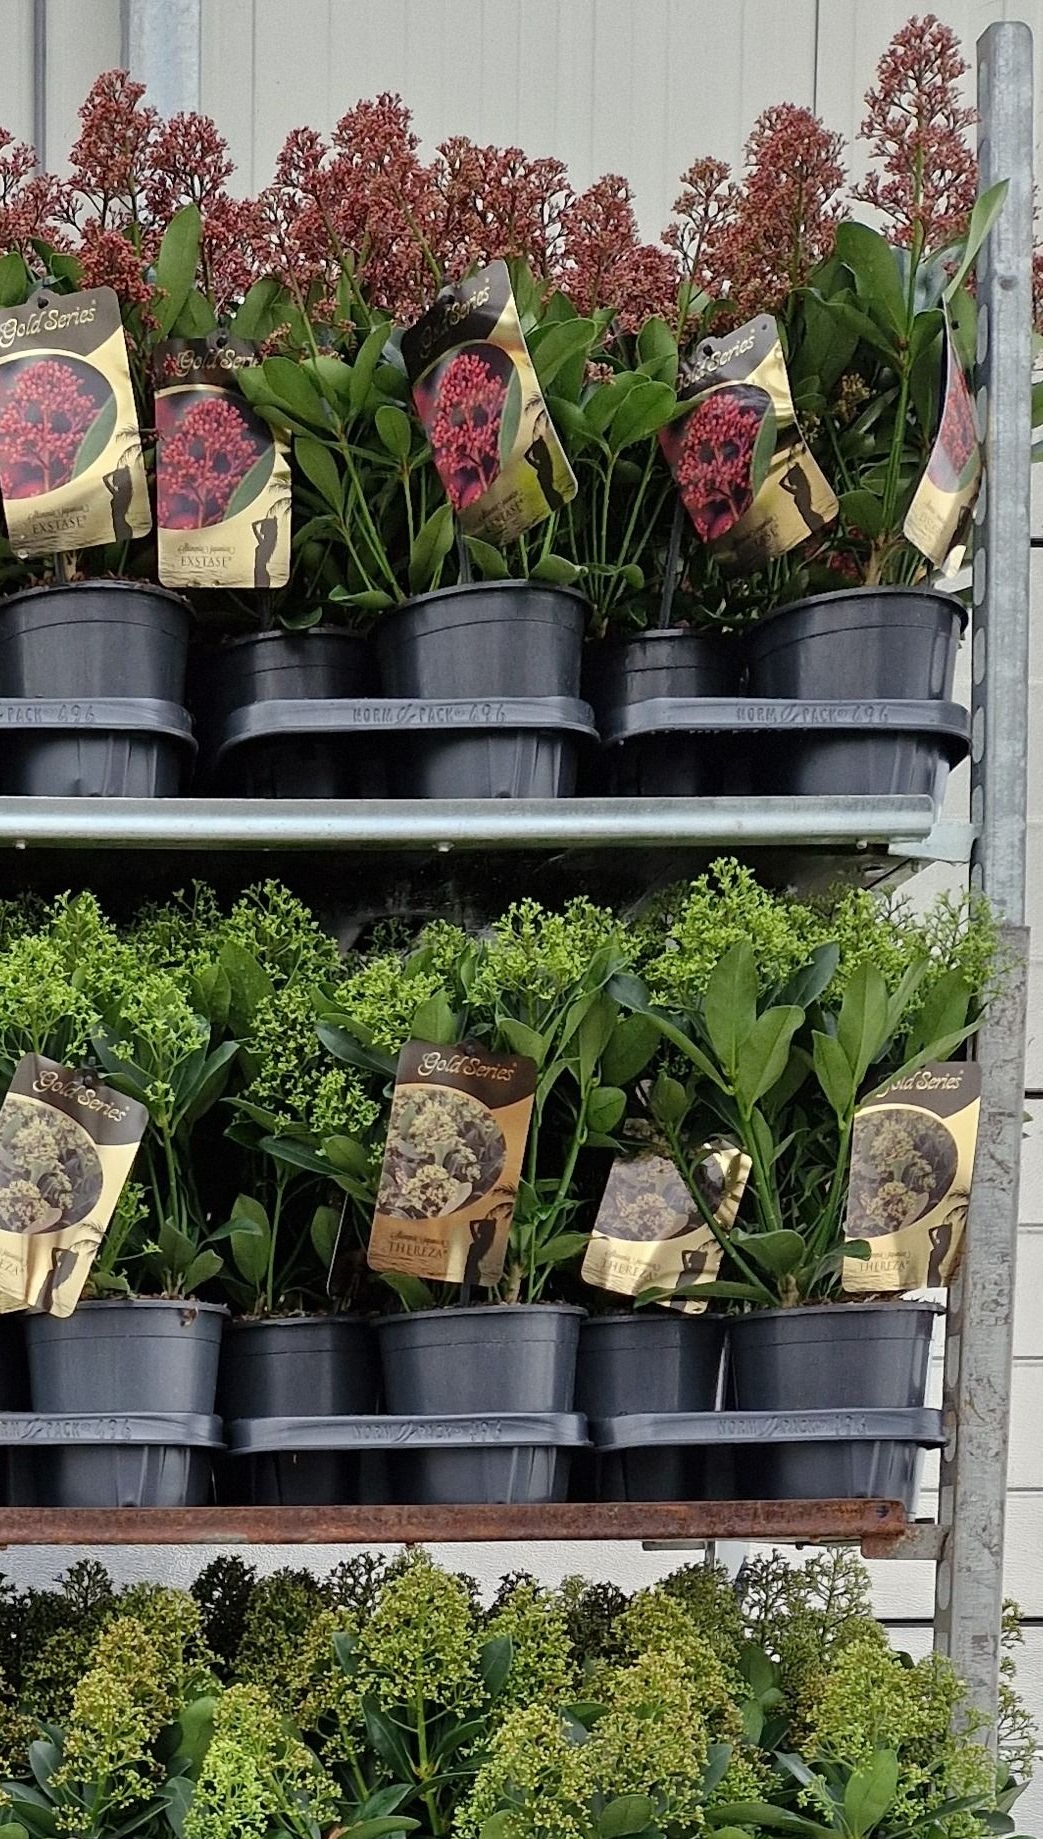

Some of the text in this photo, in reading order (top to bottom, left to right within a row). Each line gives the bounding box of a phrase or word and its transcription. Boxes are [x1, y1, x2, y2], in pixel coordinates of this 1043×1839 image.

[447, 285, 491, 326] Series
[0, 306, 96, 348] Gold Series
[176, 349, 262, 377] Gold Serie
[676, 333, 756, 392] old Series
[32, 516, 85, 534] EXSTASE
[181, 556, 228, 568] EXSTASE
[418, 1052, 515, 1081] Gold Series
[917, 1071, 962, 1090] Series
[32, 1070, 129, 1122] Gold Series
[389, 1242, 443, 1257] THEREZA
